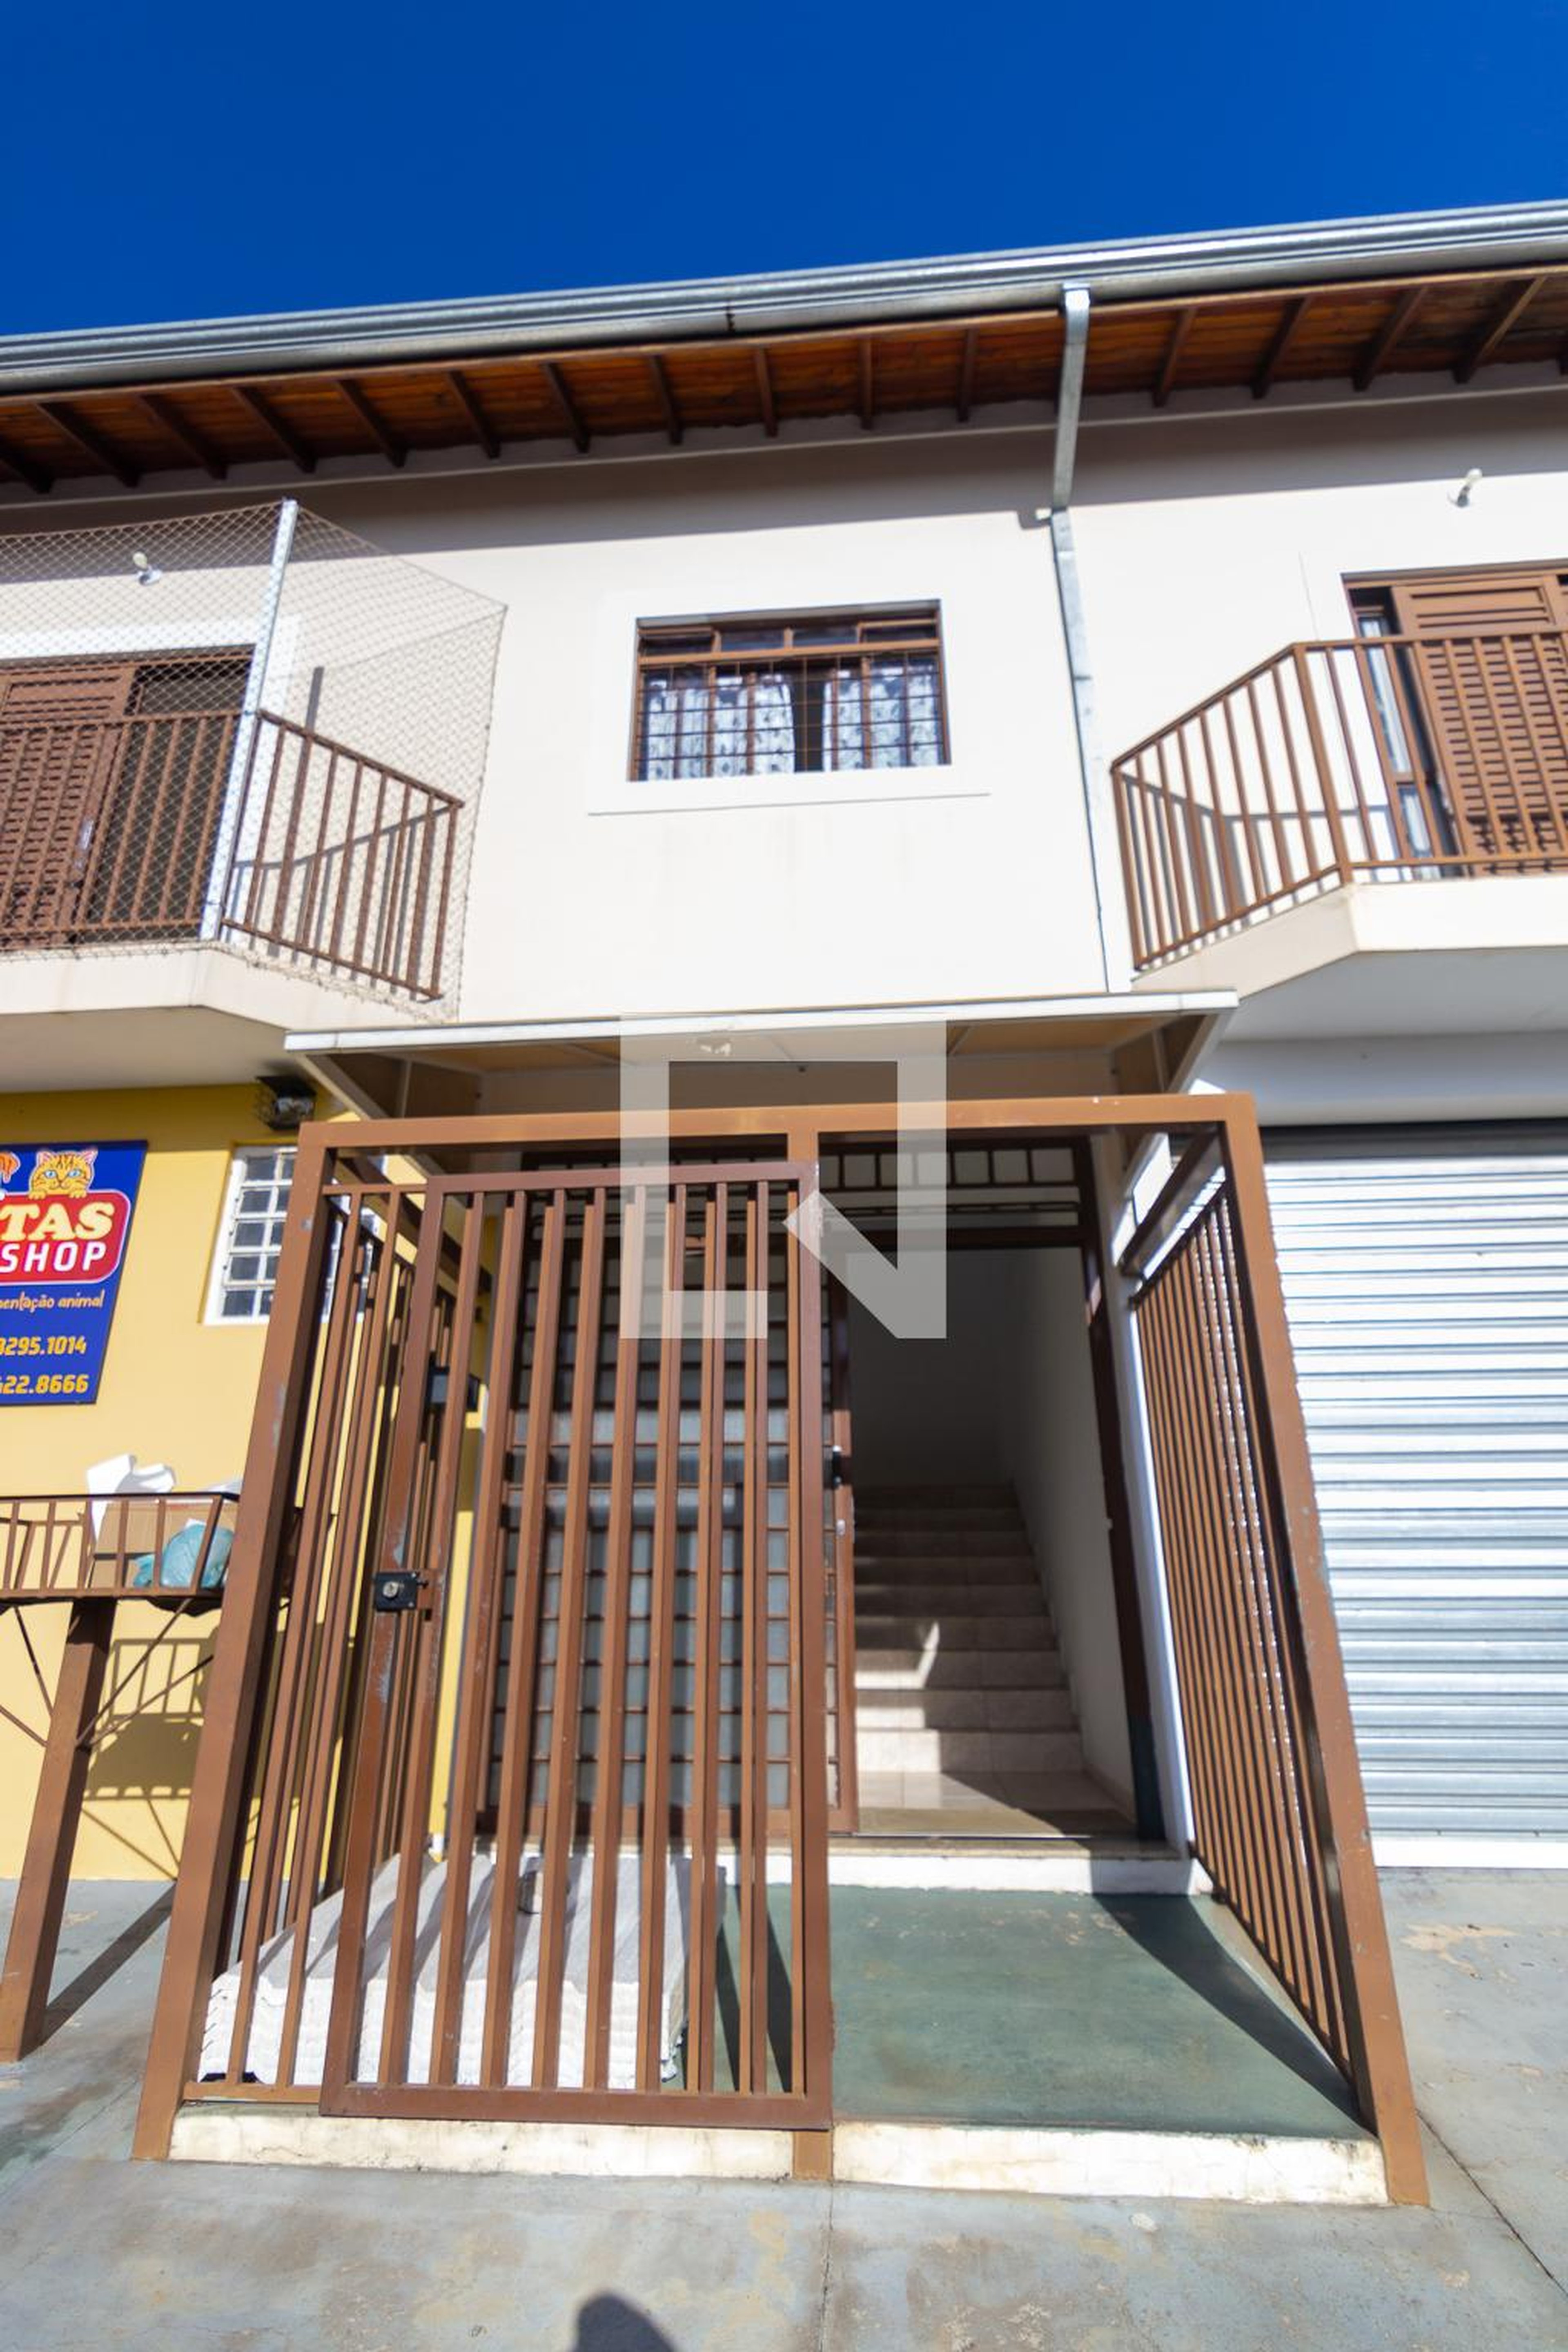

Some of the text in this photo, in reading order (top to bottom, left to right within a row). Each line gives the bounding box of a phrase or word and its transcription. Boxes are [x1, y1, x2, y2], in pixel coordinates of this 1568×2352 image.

[0, 1202, 115, 1241] TAS
[0, 1241, 106, 1273] SHOP
[58, 1289, 105, 1308] animal
